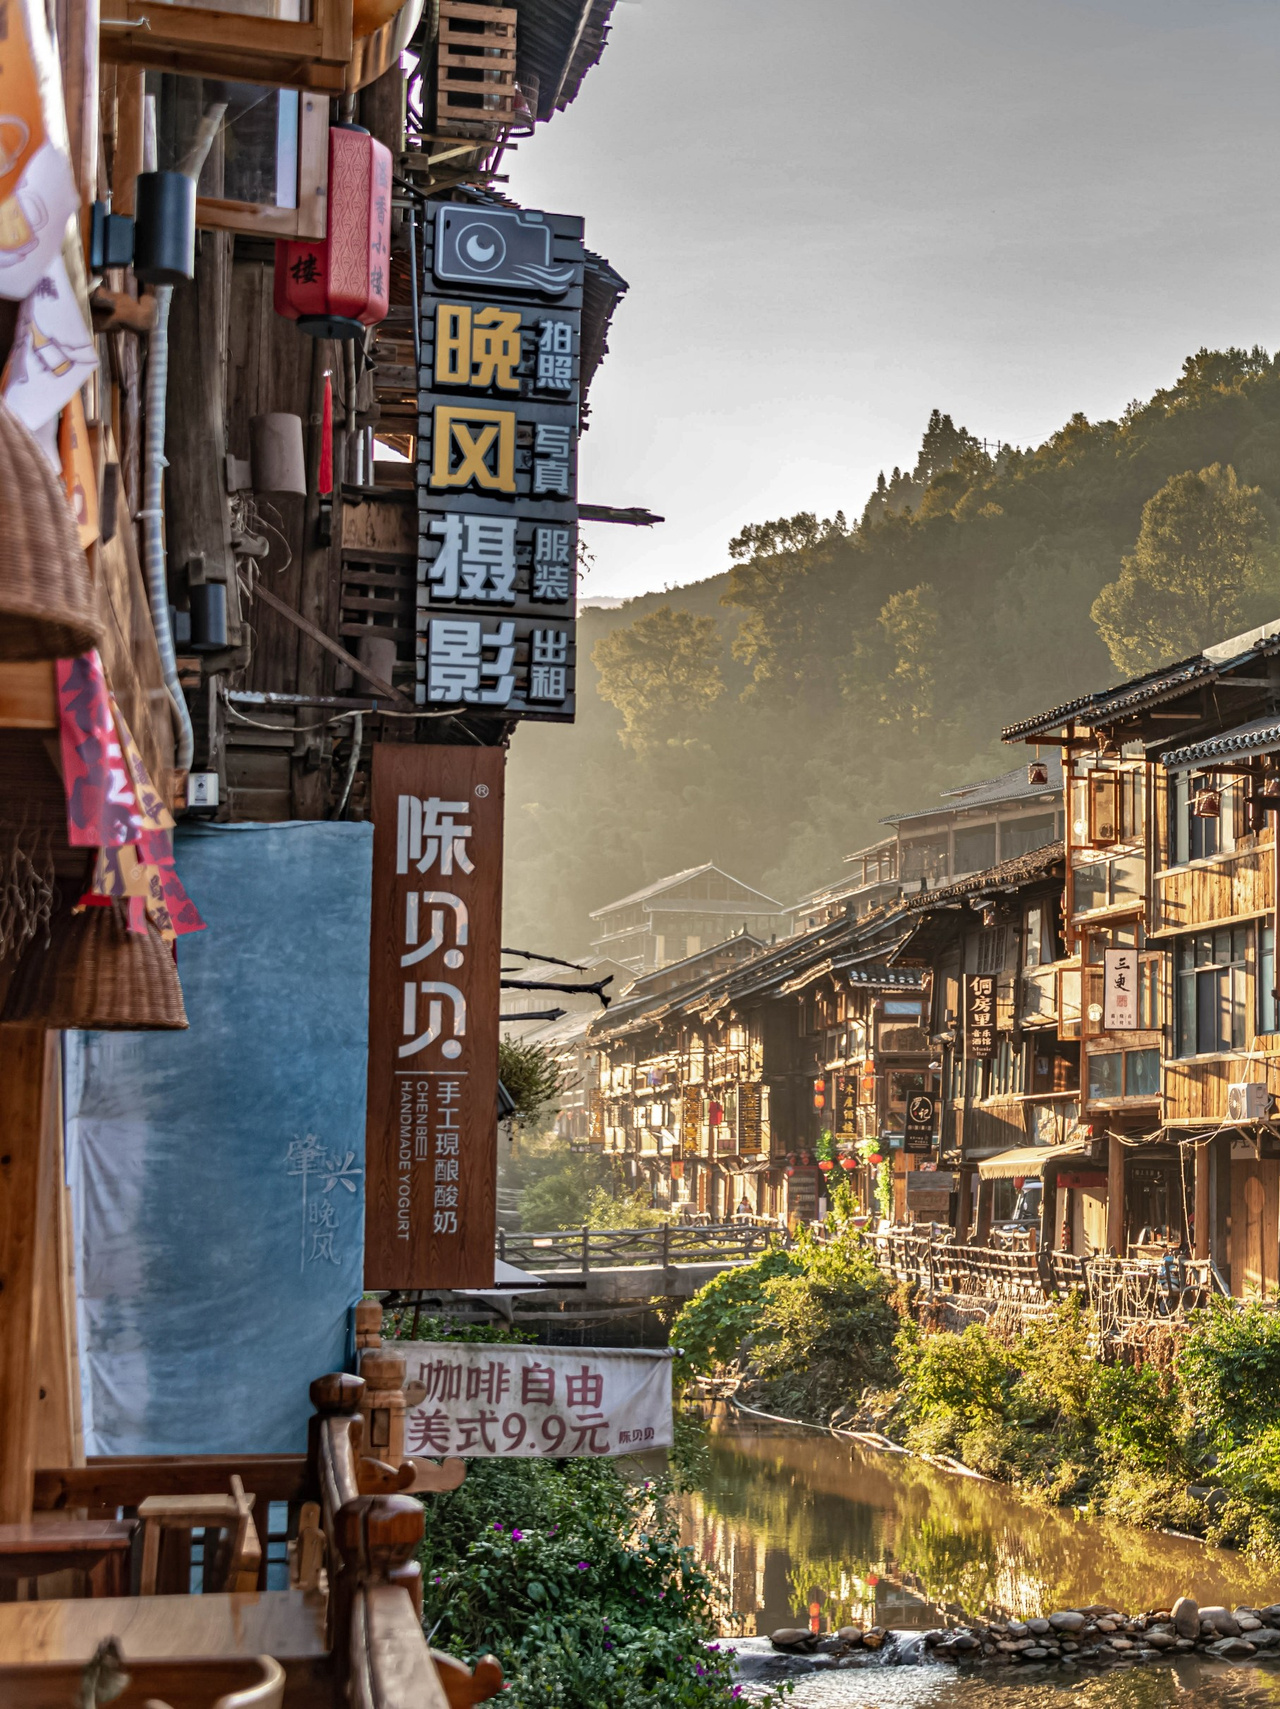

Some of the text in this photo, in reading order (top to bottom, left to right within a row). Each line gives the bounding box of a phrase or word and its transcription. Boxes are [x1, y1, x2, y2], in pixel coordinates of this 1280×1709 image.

[290, 253, 322, 285] 楼
[429, 303, 522, 704] 晚风摄影
[530, 319, 572, 701] 拍照 写真 服装 出租
[396, 795, 476, 1060] 陈贝贝
[1114, 957, 1130, 992] 三更
[415, 1081, 429, 1161] CHENBEI
[397, 1081, 413, 1240] HANDMADE YOGURT
[307, 1198, 342, 1265] 晚风
[419, 1358, 603, 1409] 咖啡自由
[408, 1408, 611, 1454] 美式9.9元
[618, 1426, 655, 1445] 陈贝贝
